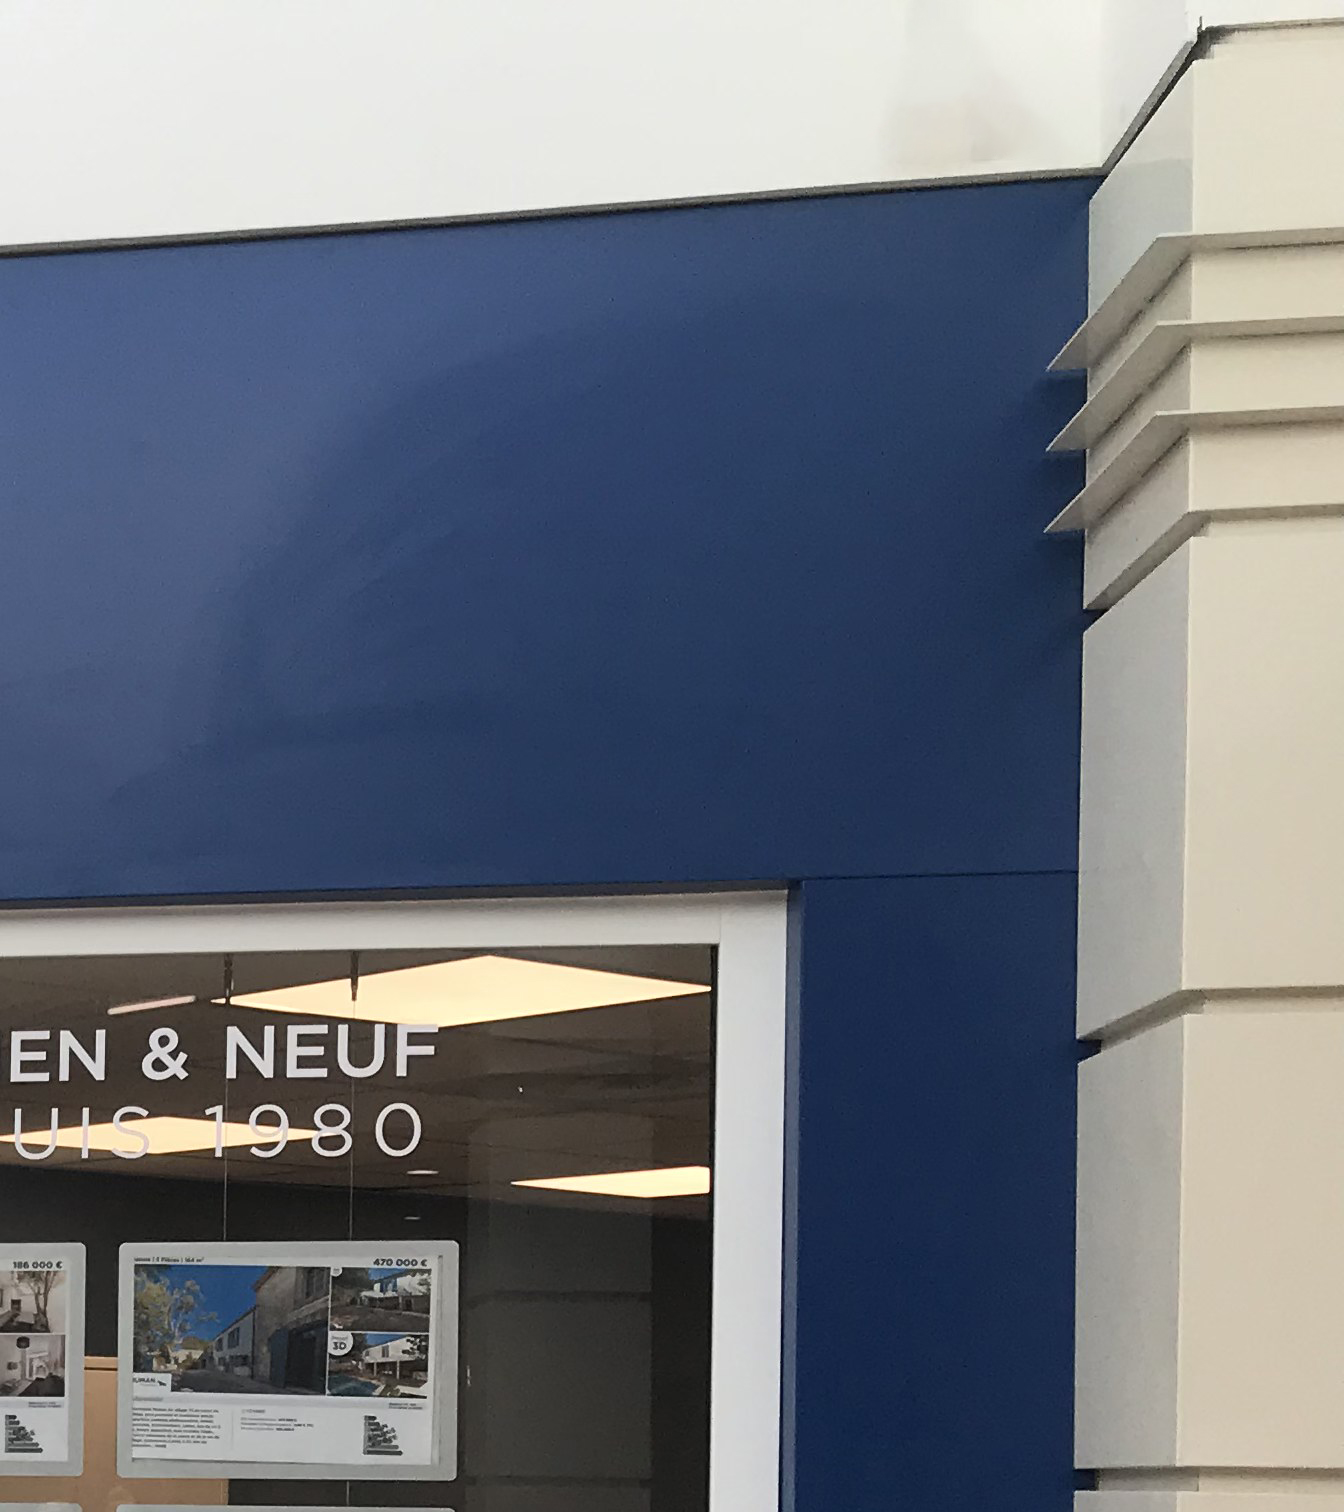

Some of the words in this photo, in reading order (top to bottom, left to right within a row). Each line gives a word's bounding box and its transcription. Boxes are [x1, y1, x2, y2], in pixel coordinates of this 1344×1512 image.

[141, 1026, 190, 1081] &
[226, 1024, 440, 1079] NEUF
[204, 1102, 424, 1158] 1980
[32, 1260, 53, 1269] 000
[373, 1258, 393, 1266] 470
[396, 1258, 418, 1267] 000
[332, 1341, 348, 1351] 3D
